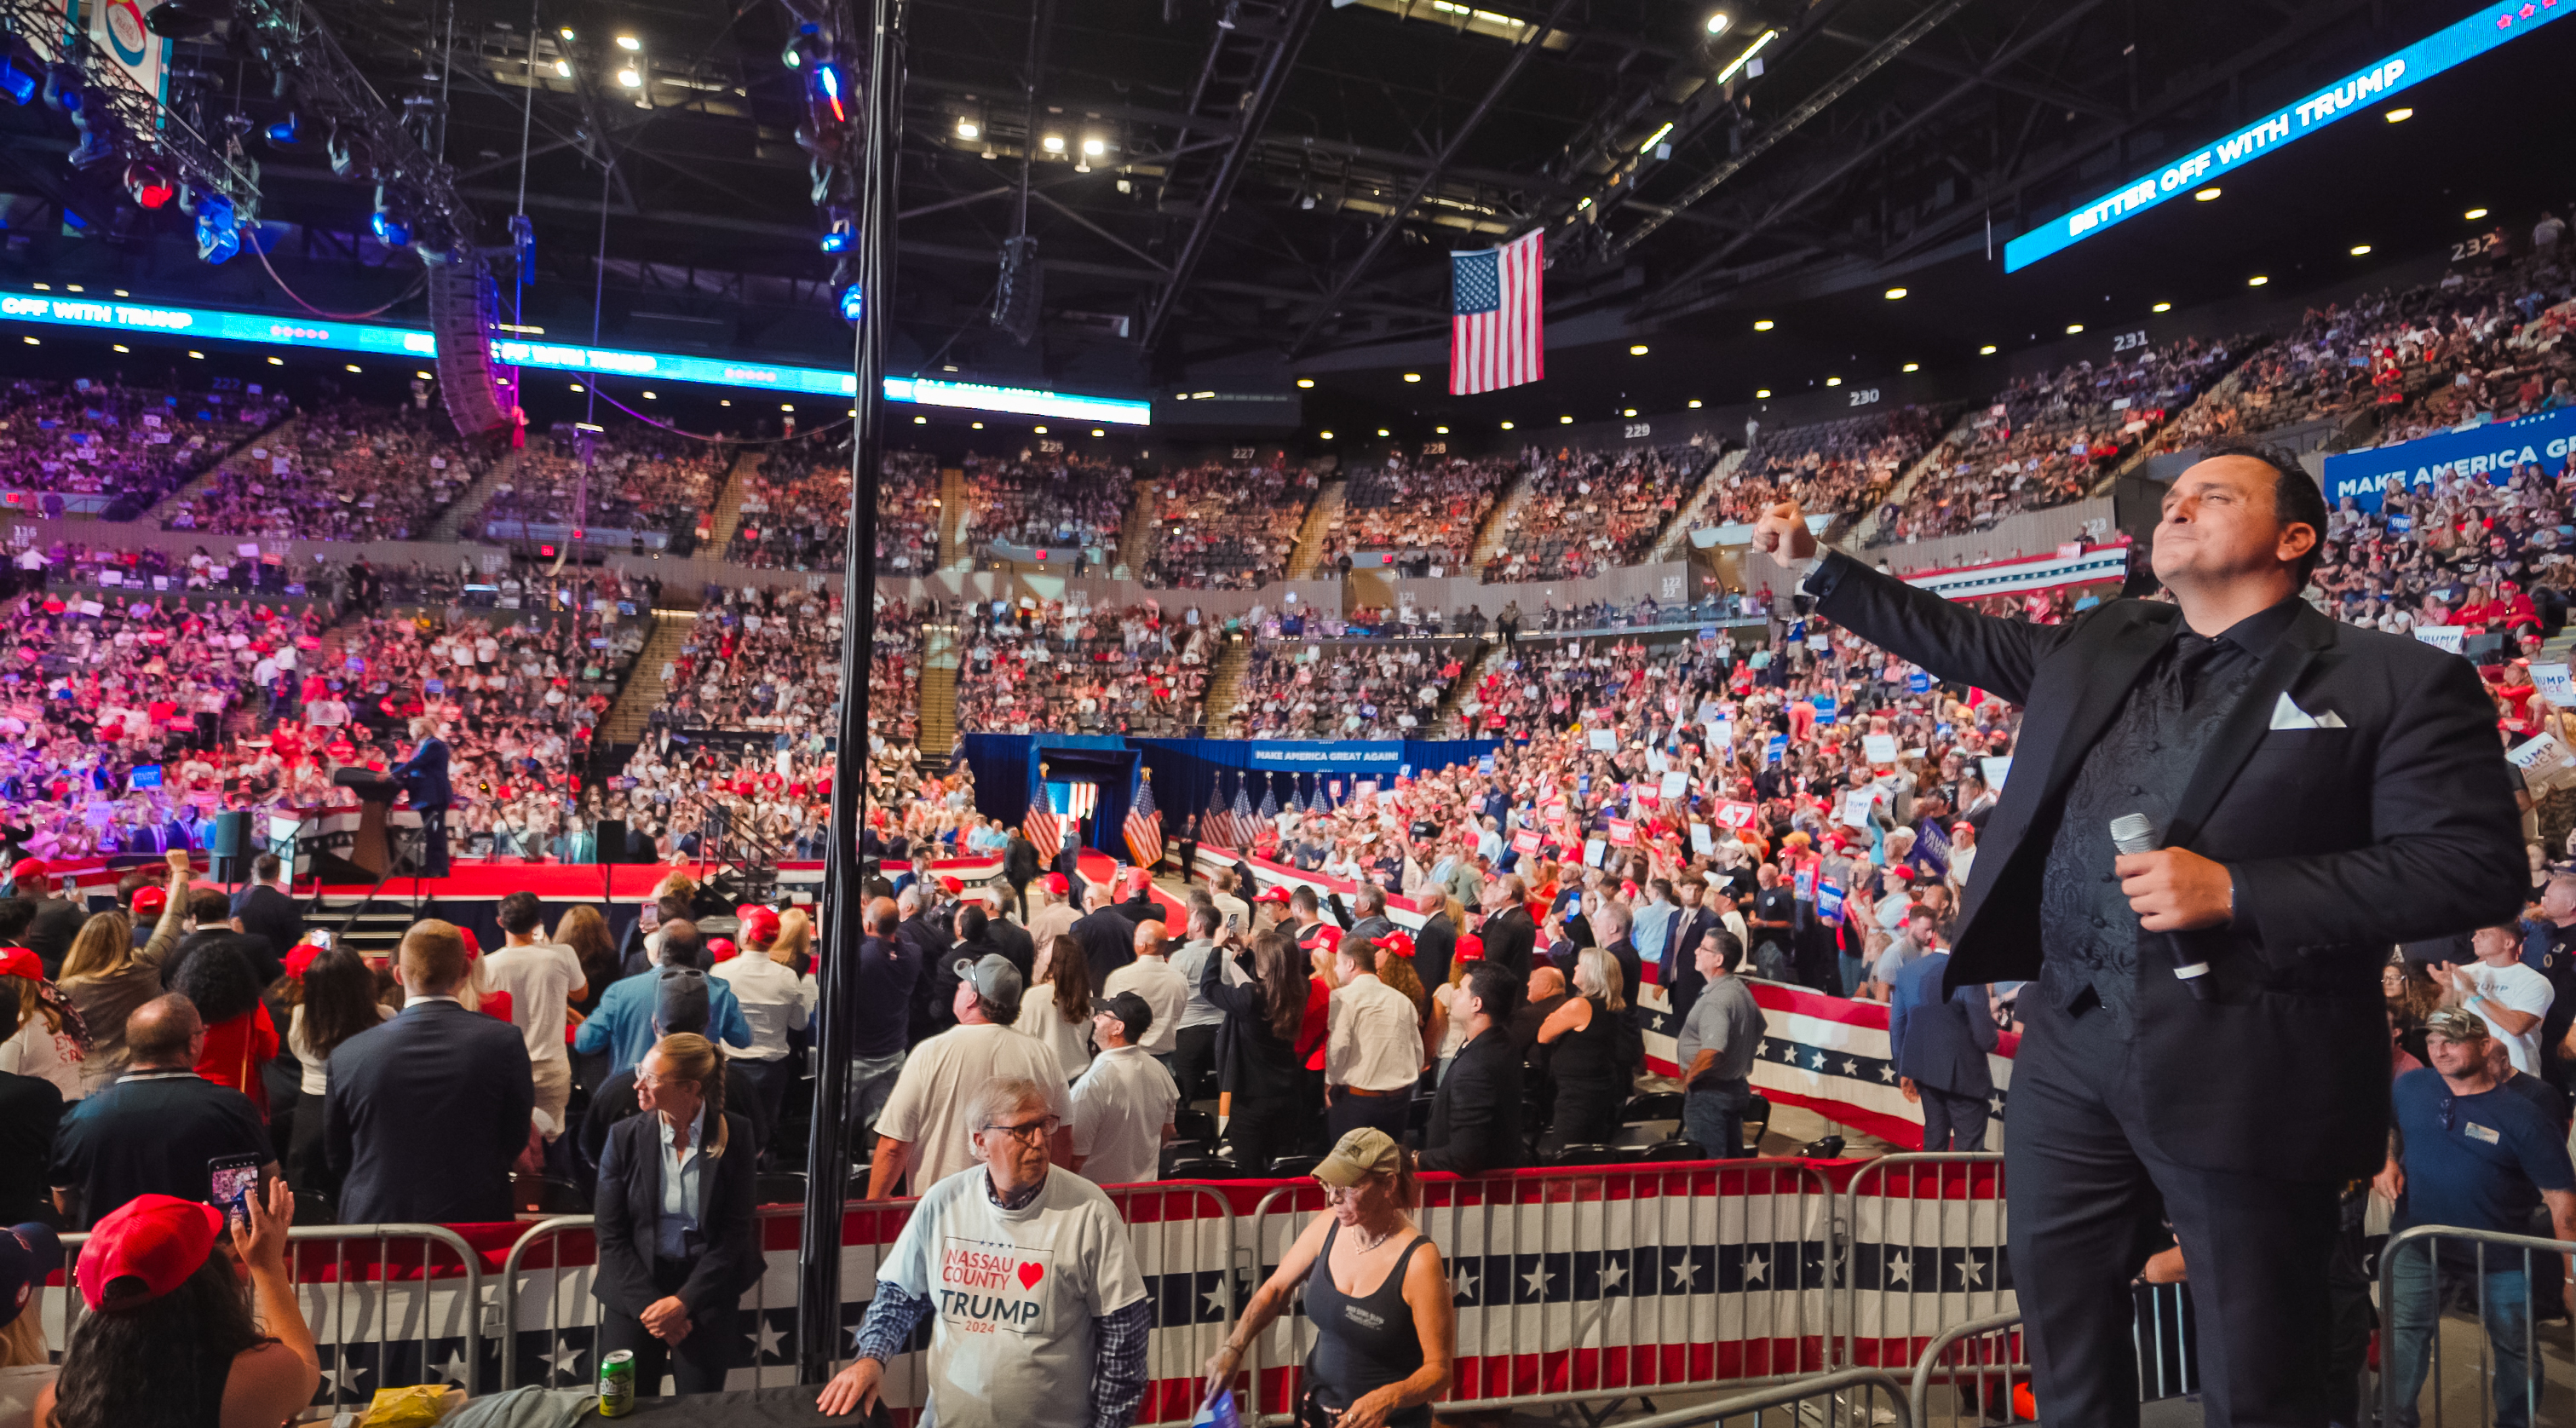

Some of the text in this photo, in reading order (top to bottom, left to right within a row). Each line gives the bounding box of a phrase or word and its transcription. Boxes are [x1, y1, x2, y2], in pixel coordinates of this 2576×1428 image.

[2069, 58, 2406, 237] BETTER OFF WITH TRUMP
[2, 298, 193, 329] OFF WITH TRUMP
[2113, 330, 2148, 353] 231
[1849, 388, 1879, 406] 230
[1624, 423, 1651, 439] 229
[1232, 448, 1256, 459] 227
[2338, 470, 2406, 498] MAKE
[2412, 446, 2539, 486] AMERICA
[1662, 576, 1682, 588] 122
[1662, 587, 1676, 598] 22
[1256, 751, 1399, 762] MAKE AMERICA GREAT AGAIN!
[1719, 804, 1753, 827] 47
[946, 1249, 1014, 1272] NASSAU
[943, 1266, 1011, 1290] COUNTY
[940, 1289, 1040, 1325] TRUMP
[965, 1321, 995, 1333] 2024
